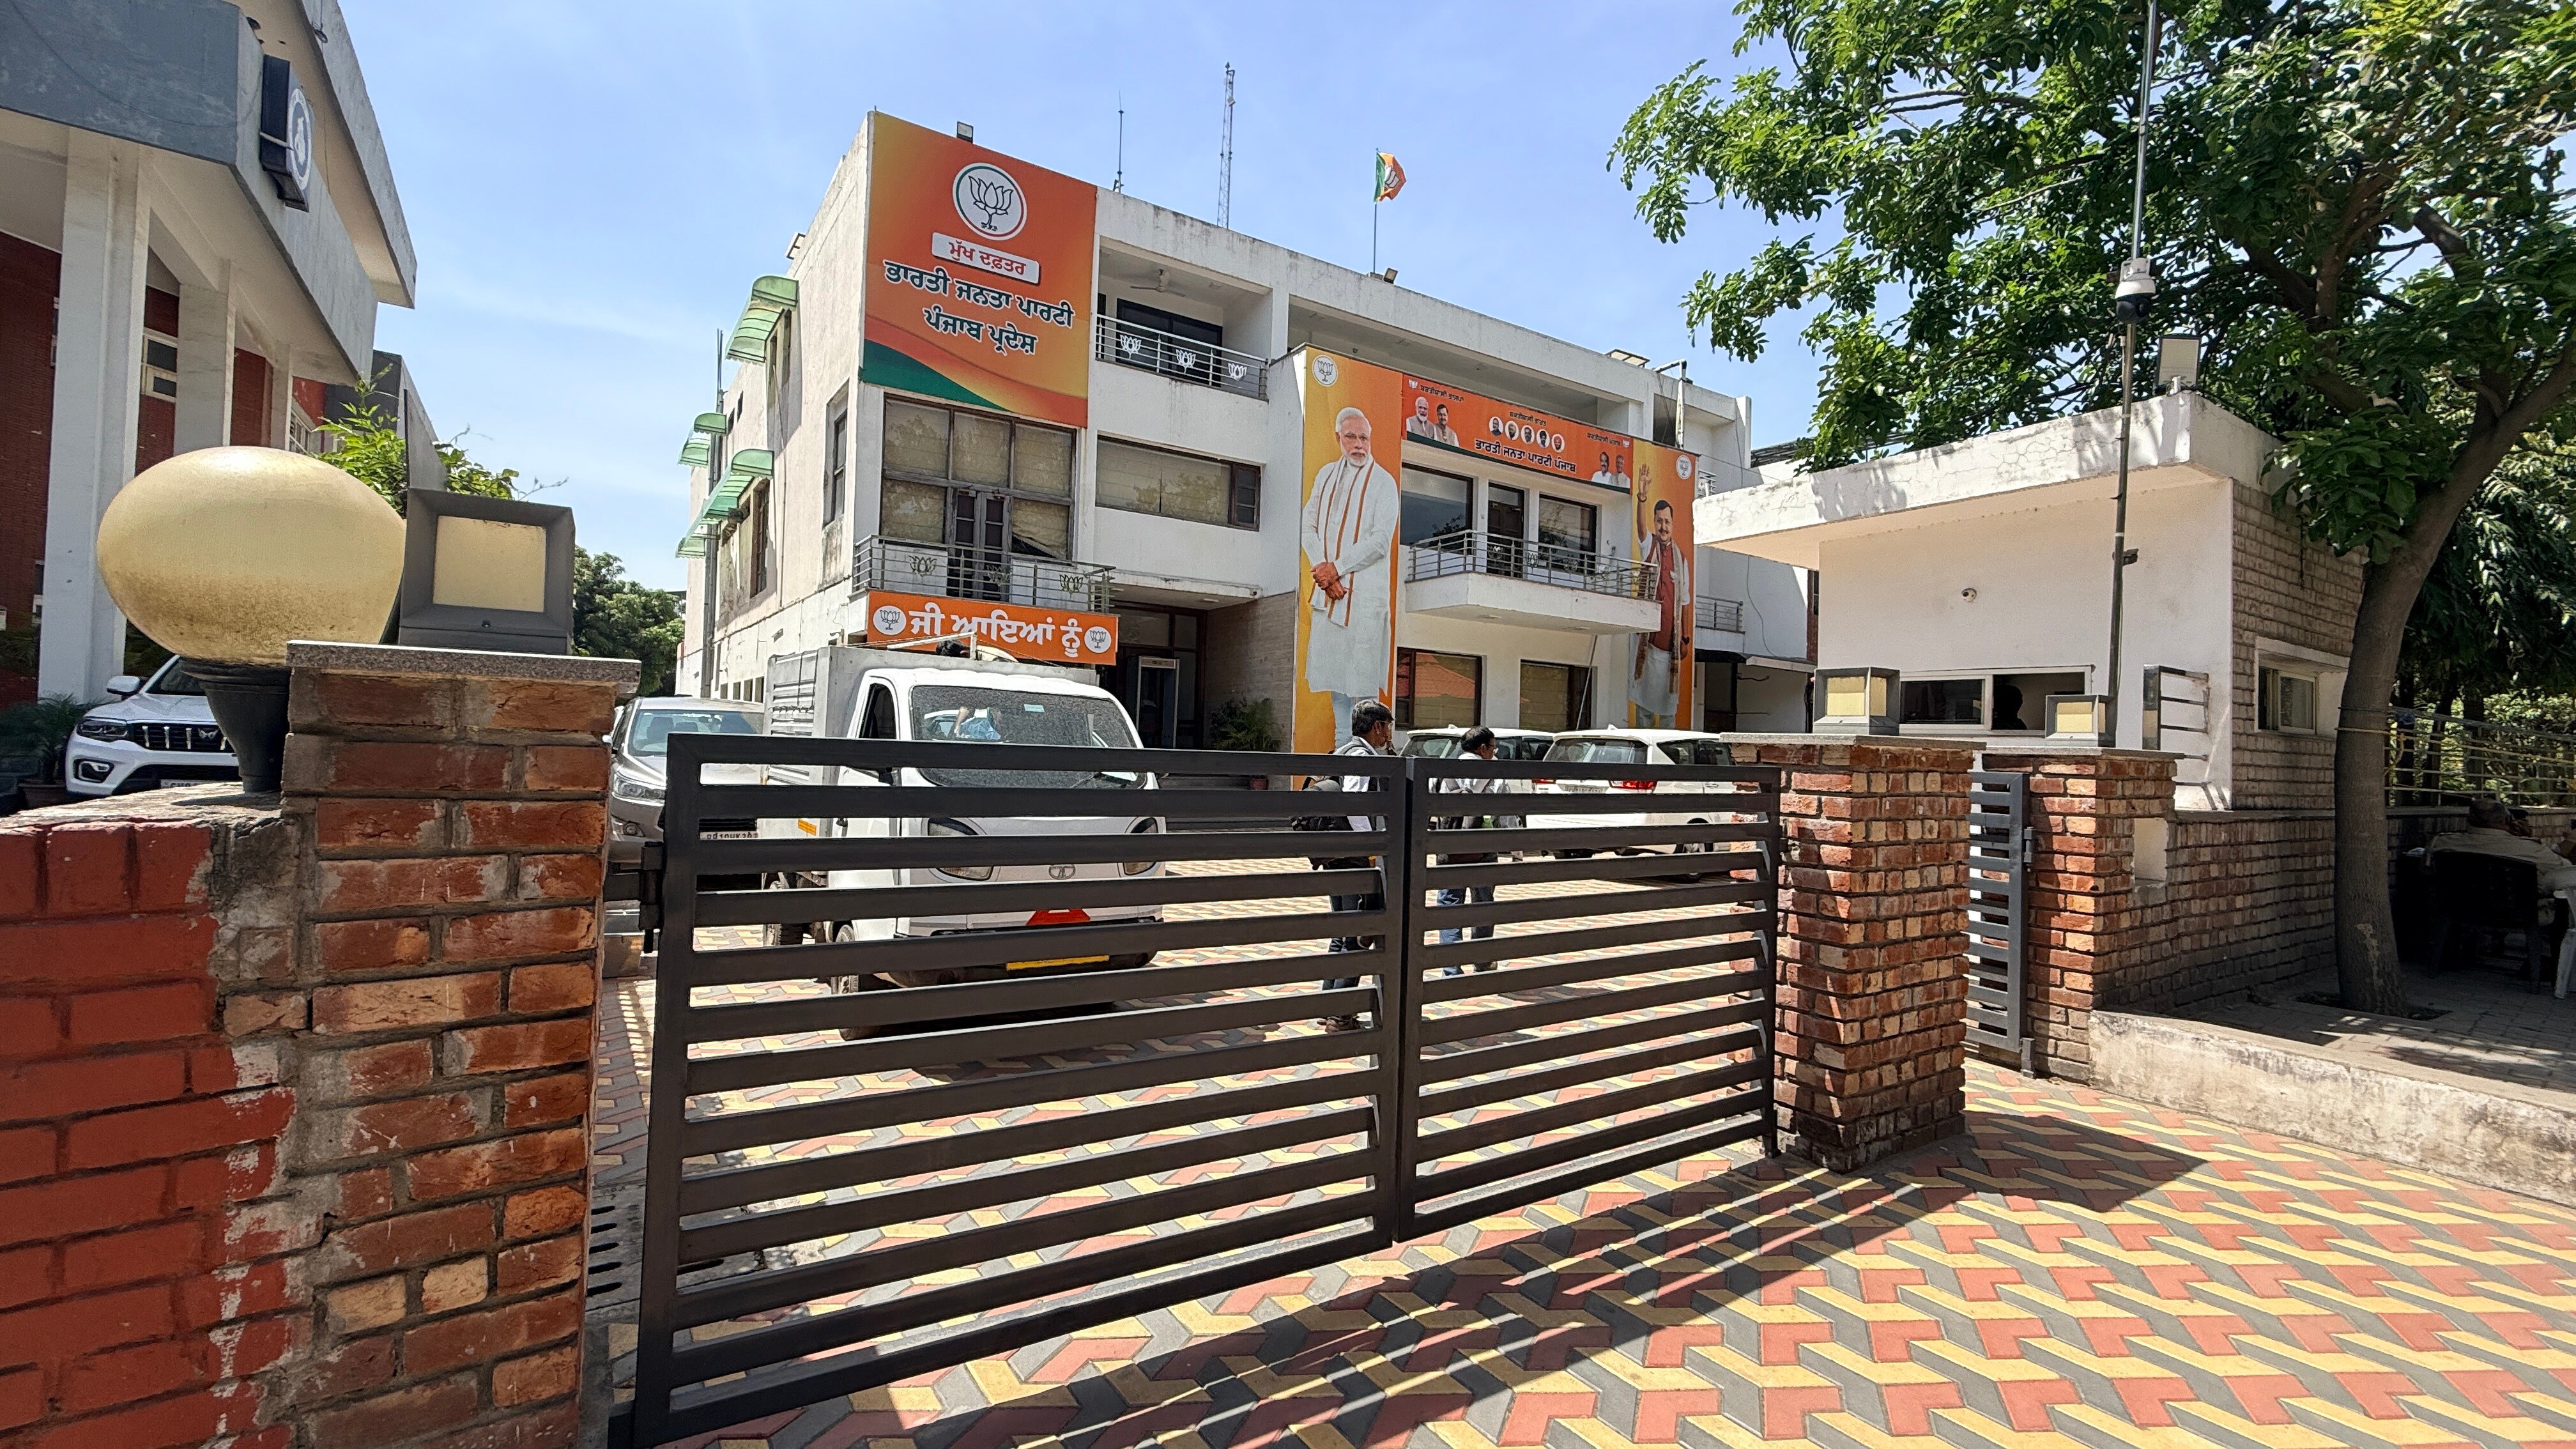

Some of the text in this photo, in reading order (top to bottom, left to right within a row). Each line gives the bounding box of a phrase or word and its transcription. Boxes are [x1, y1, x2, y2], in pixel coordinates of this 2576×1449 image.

[949, 240, 1026, 275] ਮੁੱਖ ਦਫ਼ਤਰ
[884, 259, 1075, 328] ਭਾਰਤੀ ਜਨਤਾ ਪਾਰਟੀ
[924, 305, 1038, 355] ਪੰਜਾਬ ਪ੍ਰਦੇਸ਼
[1475, 439, 1576, 473] ਭਾਰਤੀ ਜਨਤਾ ਪਾਰਟੀ ਪੰਜਾਬ
[908, 602, 1082, 658] ਜੀ ਆਇਆਂ ਨੂੰ
